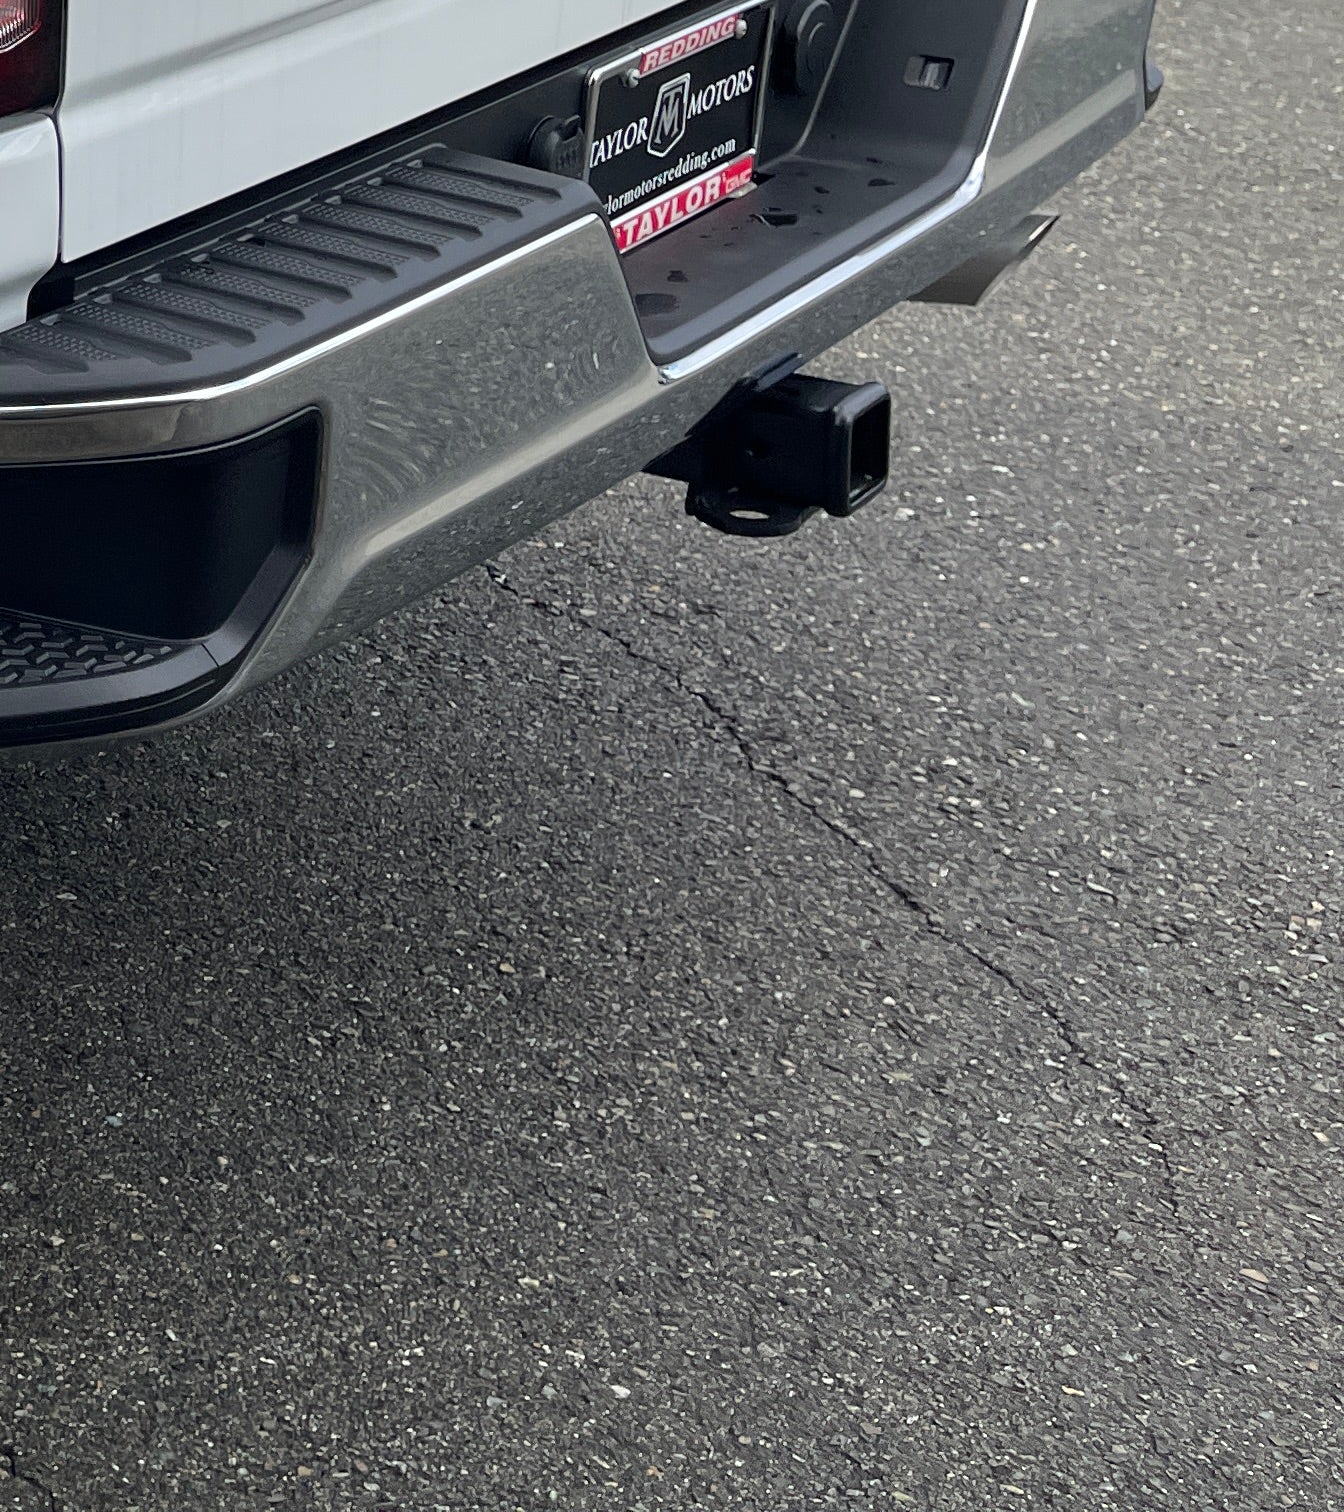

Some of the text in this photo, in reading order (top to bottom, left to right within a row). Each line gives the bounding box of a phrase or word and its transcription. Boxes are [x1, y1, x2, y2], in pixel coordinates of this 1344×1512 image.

[643, 17, 736, 72] REDDING
[590, 117, 648, 168] TAYLOR
[687, 65, 754, 119] MOTORS
[623, 175, 722, 246] TAYLOR
